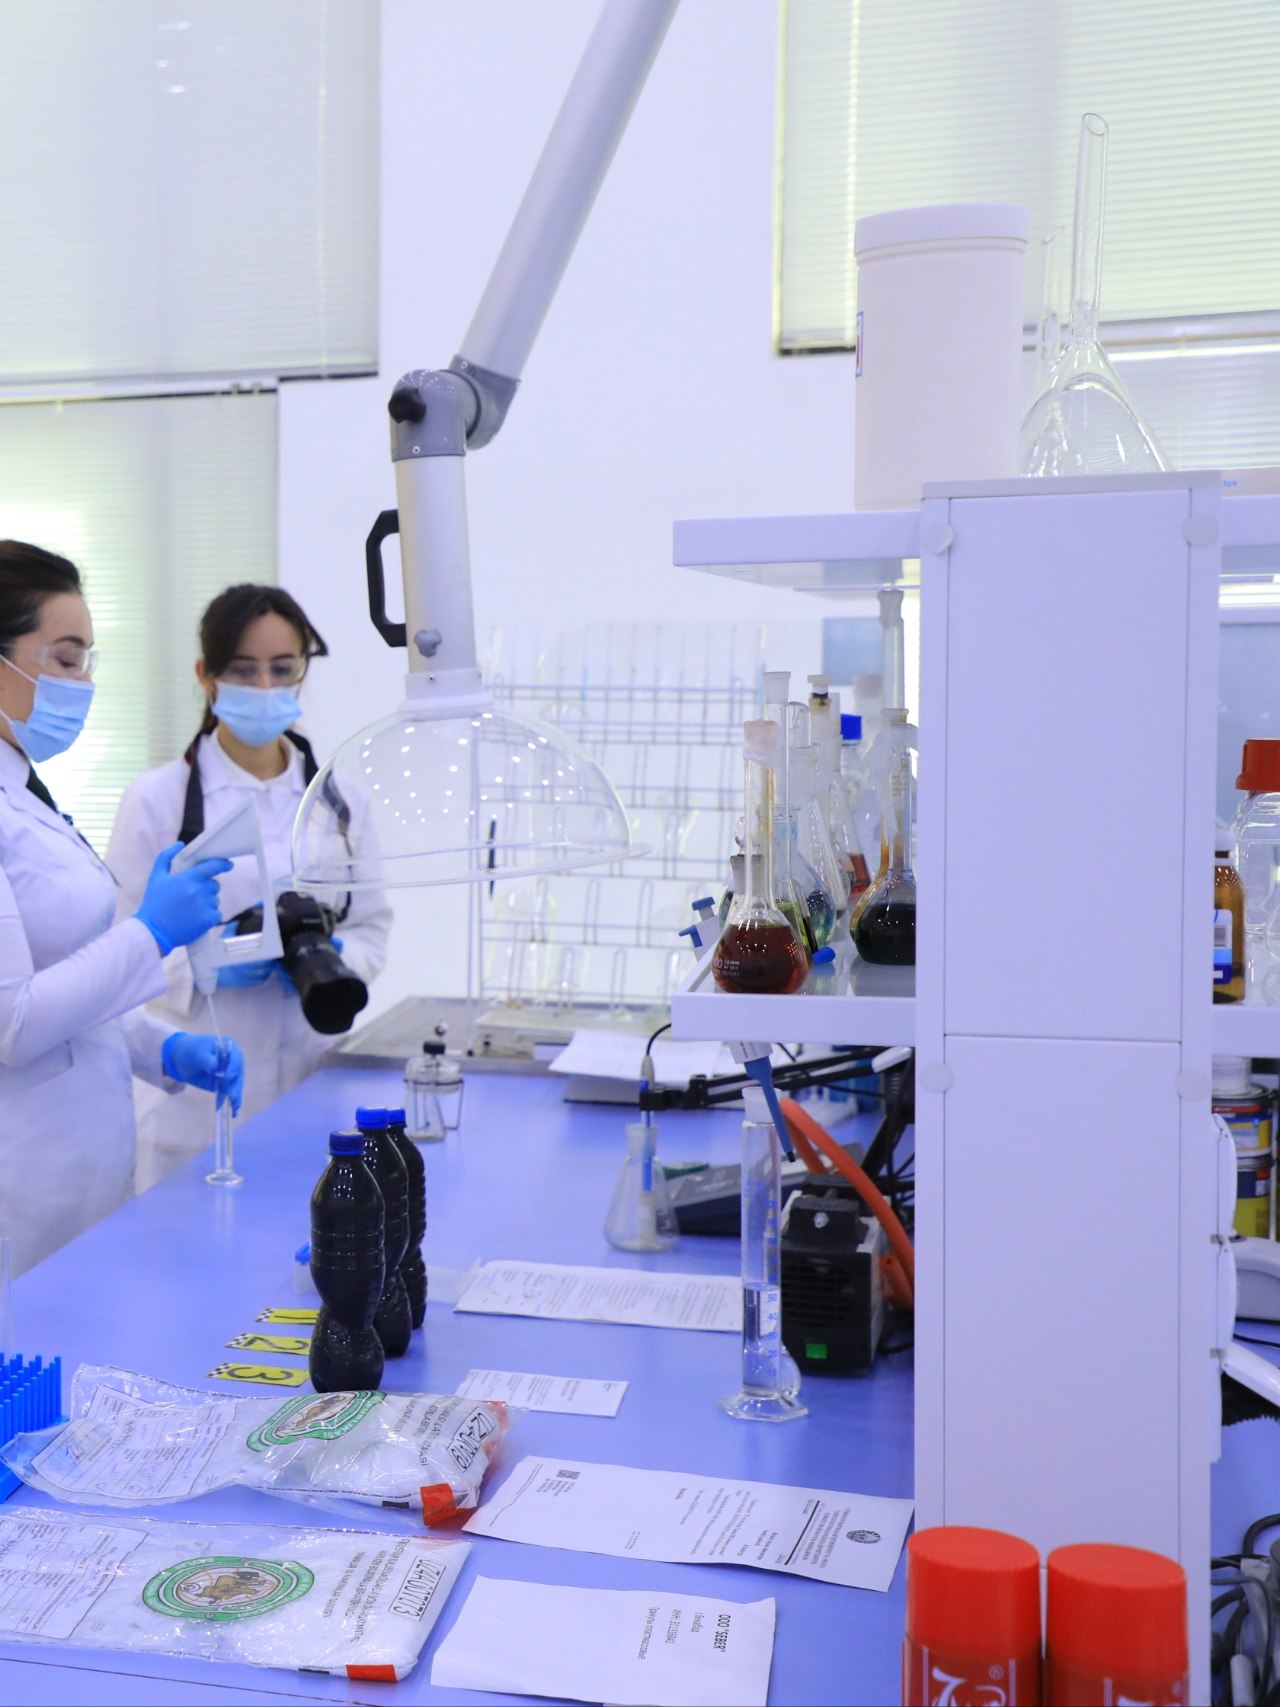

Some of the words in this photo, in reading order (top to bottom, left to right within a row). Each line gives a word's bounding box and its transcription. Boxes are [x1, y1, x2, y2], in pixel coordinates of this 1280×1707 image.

[767, 1293, 778, 1302] 50
[767, 1312, 778, 1321] 40
[243, 1336, 309, 1350] 2
[227, 1366, 293, 1381] 3
[713, 1628, 729, 1652] "SEBER"
